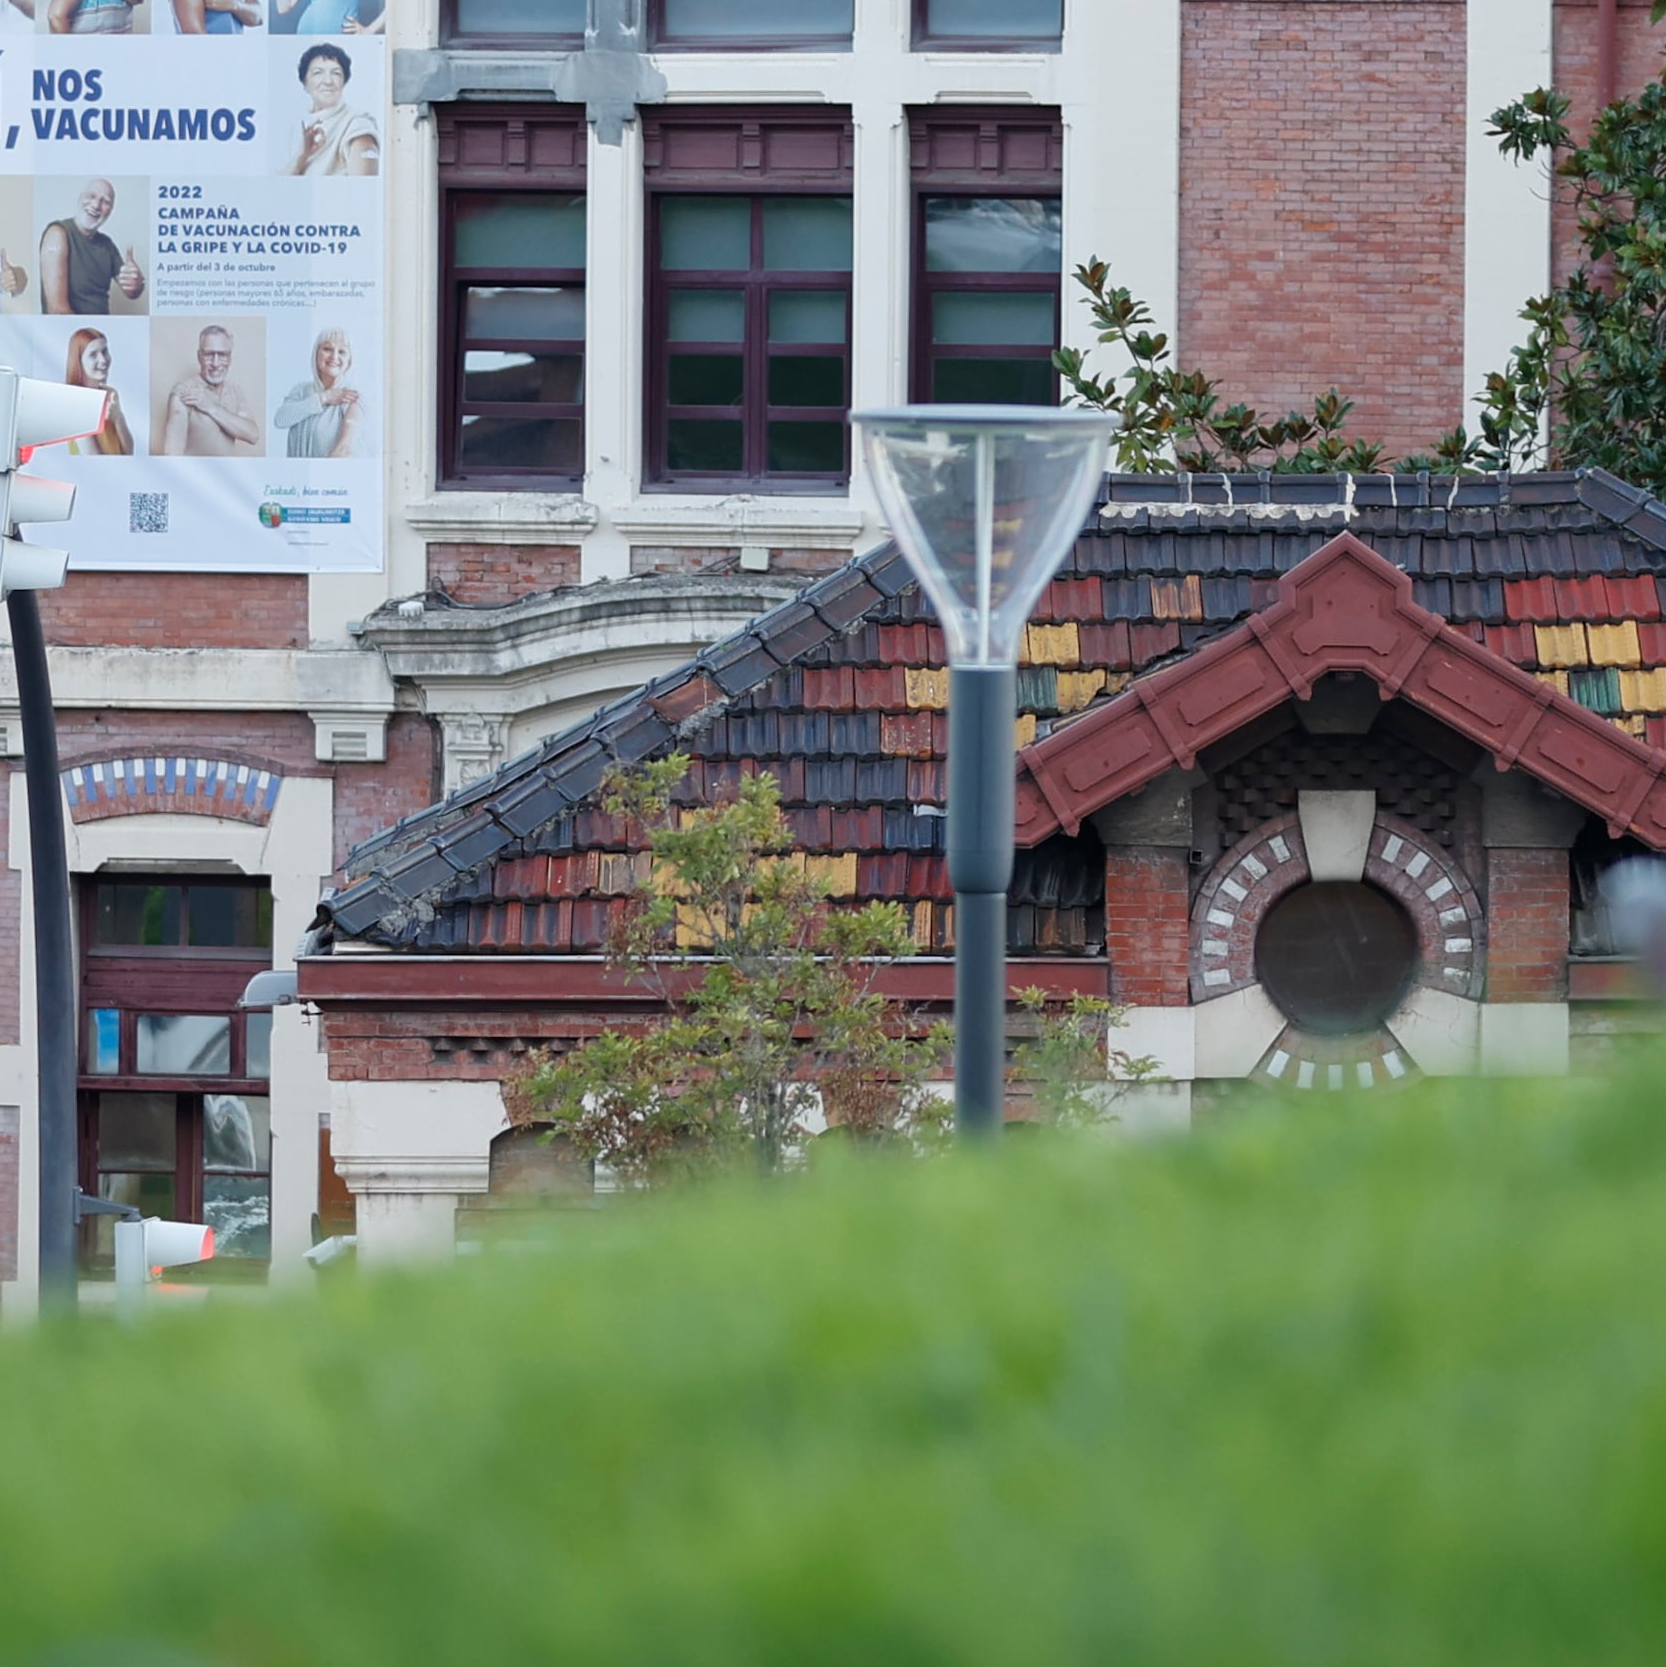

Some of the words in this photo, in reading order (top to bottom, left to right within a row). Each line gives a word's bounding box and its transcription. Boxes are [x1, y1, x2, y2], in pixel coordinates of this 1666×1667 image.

[32, 69, 103, 101] NOS
[31, 108, 256, 141] VACUNAMOS
[158, 185, 202, 199] 2022
[158, 205, 240, 219] CAMPAÑA
[158, 225, 178, 236] DE
[183, 222, 290, 237] VACUNACIÓN
[295, 225, 361, 237] CONTRA
[158, 242, 177, 253] LA
[181, 241, 228, 253] GRIPE
[232, 242, 243, 253] Y
[247, 242, 266, 253] LA
[270, 242, 347, 254] COVID-19
[157, 263, 164, 271] A
[167, 262, 194, 273] partir
[196, 262, 212, 271] del
[214, 263, 221, 271] 3
[223, 262, 236, 271] de
[238, 262, 276, 271] octubre
[224, 279, 235, 287] las
[238, 280, 273, 289] personas
[276, 280, 291, 289] que
[293, 279, 339, 289] pertenecen
[350, 281, 375, 289] grupo
[157, 289, 167, 297] de
[169, 289, 195, 298] riesgo
[238, 290, 271, 299] mayores
[157, 300, 192, 309] personas
[212, 298, 270, 307] enfermedades
